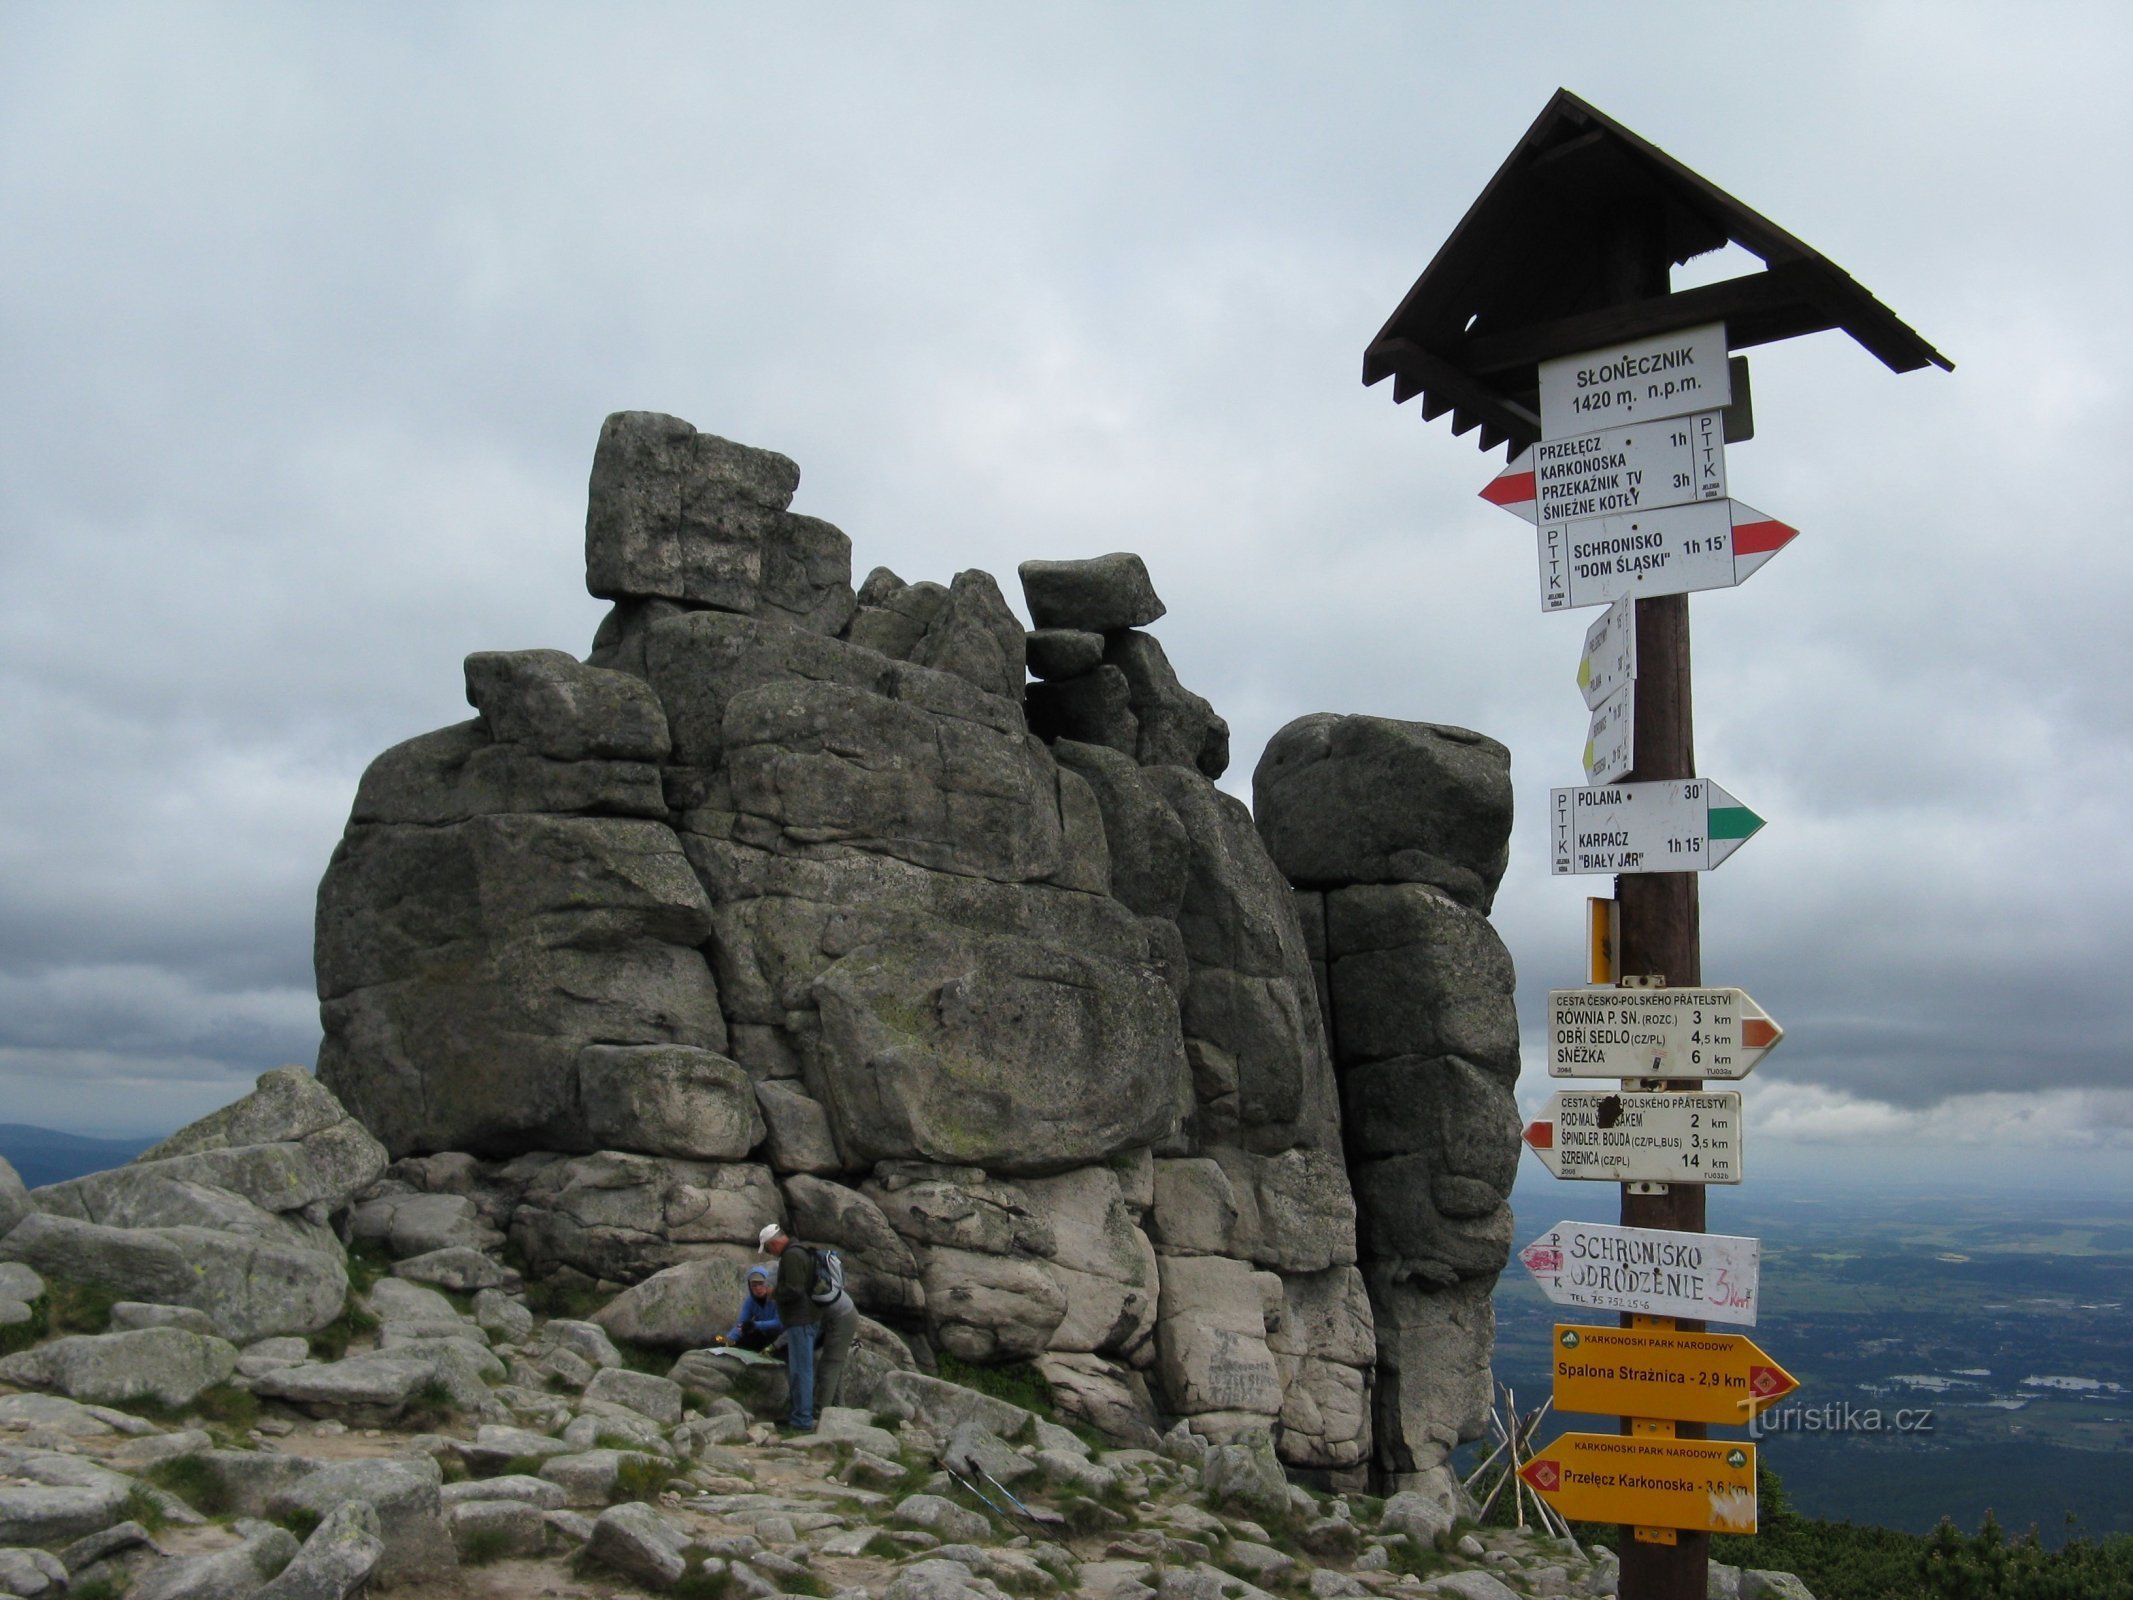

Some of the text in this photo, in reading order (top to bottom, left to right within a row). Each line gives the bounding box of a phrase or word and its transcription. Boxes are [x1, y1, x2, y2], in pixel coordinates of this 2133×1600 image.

[1576, 346, 1694, 388] SŁONECZNIK
[1573, 376, 1701, 413] 1420 m. n.p.m.
[1540, 432, 1687, 461] PRZEŁĘCZ 1h
[1701, 417, 1716, 478] PTTK
[1541, 453, 1626, 480] KARKONOSKA
[1542, 470, 1690, 500] PRZEKAŹNIK TV 3h
[1600, 491, 1640, 512] KOTŁY
[1574, 533, 1663, 559] SCHRONISKO
[1683, 540, 1700, 555] 1h
[1547, 530, 1562, 589] PTTK
[1574, 552, 1670, 579] "DOM ŚLĄSKI"
[1578, 790, 1622, 806] POLANA
[1558, 794, 1567, 854] PTTK
[1579, 832, 1629, 848] KARPACZ
[1668, 838, 1682, 853] 1h
[1579, 852, 1644, 868] "BIAŁY JAR"
[1556, 993, 1732, 1007] CESTA ČESKO-POLSKÉHO PŘÁTELSTVÍ
[1556, 1008, 1605, 1025] RÓWNIA
[1608, 1011, 1617, 1025] P.
[1642, 1015, 1678, 1027] (ROZC.)
[1693, 1010, 1702, 1025] 3
[1714, 1015, 1732, 1025] km
[1557, 1027, 1732, 1047] OBŘÍ SEDLO (CZ/PL) 4,5 km
[1691, 1050, 1701, 1064] 6
[1714, 1055, 1732, 1065] km
[1561, 1098, 1588, 1108] CESTA
[1690, 1114, 1700, 1128] 2
[1711, 1119, 1728, 1129] km
[1602, 1132, 1631, 1146] BOUDA
[1691, 1133, 1709, 1149] 3,5
[1711, 1138, 1728, 1149] km
[1561, 1151, 1729, 1169] SZRENICA (CZ/PL) 14 km
[1570, 1234, 1703, 1270] SCHRONISKO
[1584, 1335, 1734, 1352] KARKONOSKI PARK NARODOWY
[1558, 1362, 1615, 1380] Spalona
[1619, 1366, 1685, 1384] Strażnica
[1698, 1372, 1720, 1388] 2,9
[1724, 1374, 1746, 1388] km
[1574, 1442, 1723, 1459] KARKONOSKI PARK NARODOWY
[1564, 1470, 1615, 1488] Przełęcz
[1619, 1474, 1694, 1492] Karkonoska
[1705, 1480, 1725, 1495] 3,6
